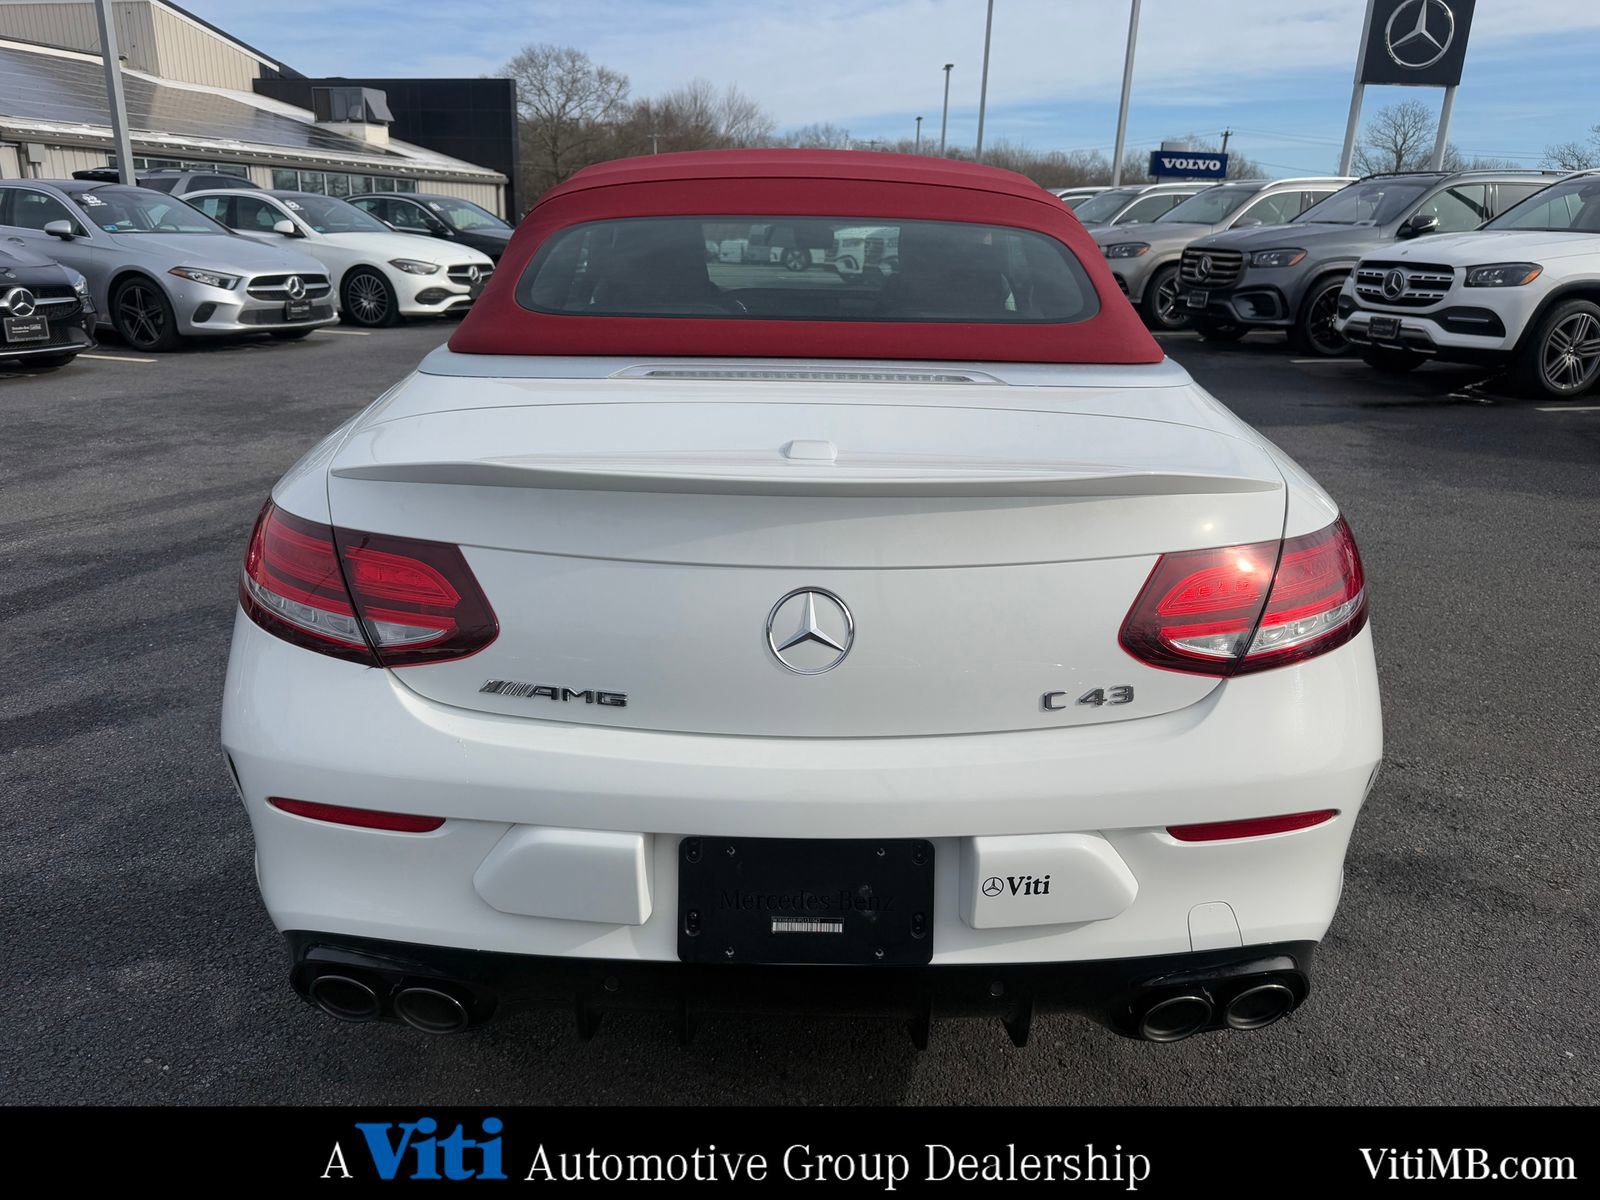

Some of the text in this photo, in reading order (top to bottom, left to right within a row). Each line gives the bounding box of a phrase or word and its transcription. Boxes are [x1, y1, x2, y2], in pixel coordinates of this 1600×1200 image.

[1161, 158, 1221, 171] VOLVO
[526, 685, 628, 707] AMG
[1041, 685, 1135, 711] C 43
[1006, 874, 1051, 897] Viti
